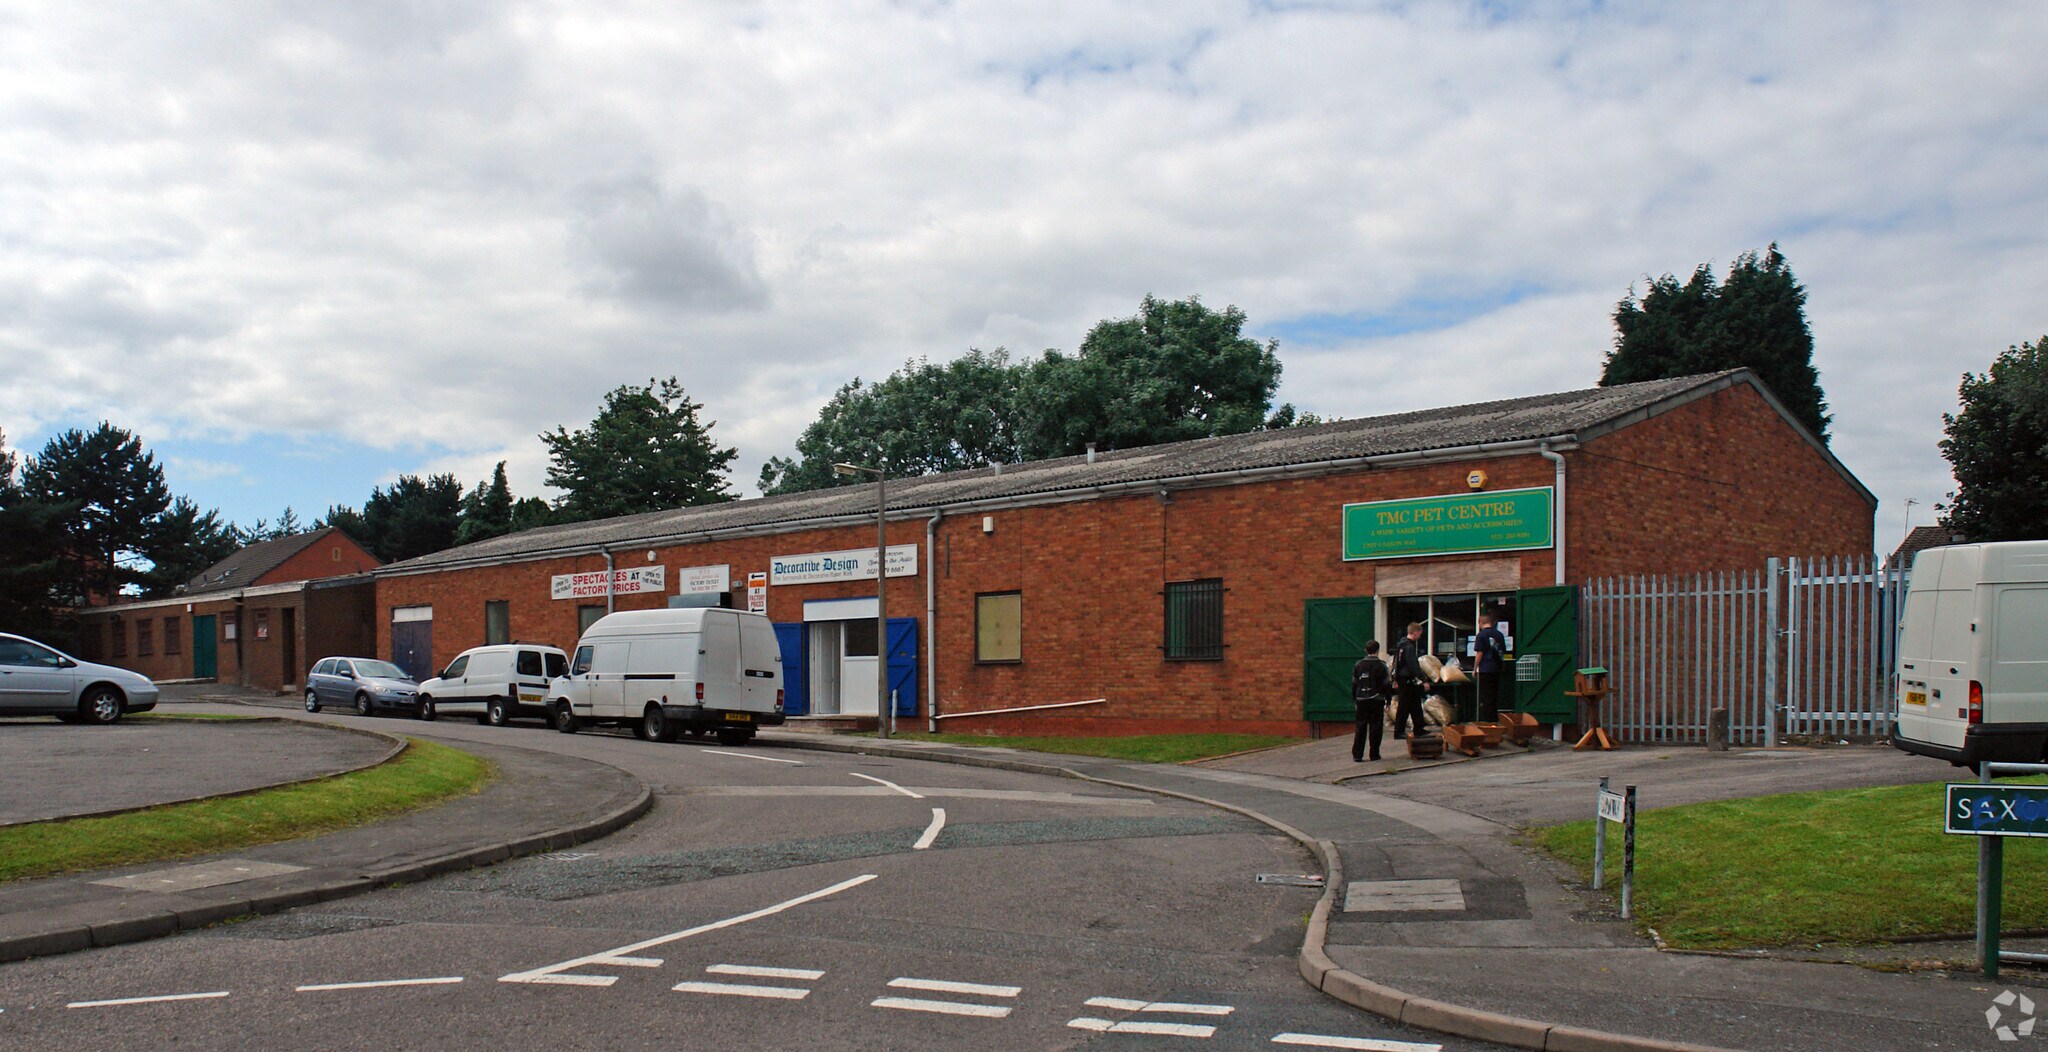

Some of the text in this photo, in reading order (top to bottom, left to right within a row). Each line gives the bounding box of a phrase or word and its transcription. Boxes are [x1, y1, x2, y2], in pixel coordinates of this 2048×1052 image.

[1377, 501, 1515, 525] TMC PET CENTRE
[1396, 526, 1423, 534] VARIETY
[1457, 522, 1472, 530] AND
[1473, 519, 1523, 528] ACCESSORIES
[774, 557, 859, 575] Decorative Design
[891, 565, 904, 573] 6667
[631, 572, 640, 581] AT
[650, 578, 662, 586] PUBLIC
[560, 584, 571, 592] PUBLIC
[573, 585, 608, 596] FACTORY
[1957, 797, 2048, 822] SAXO
